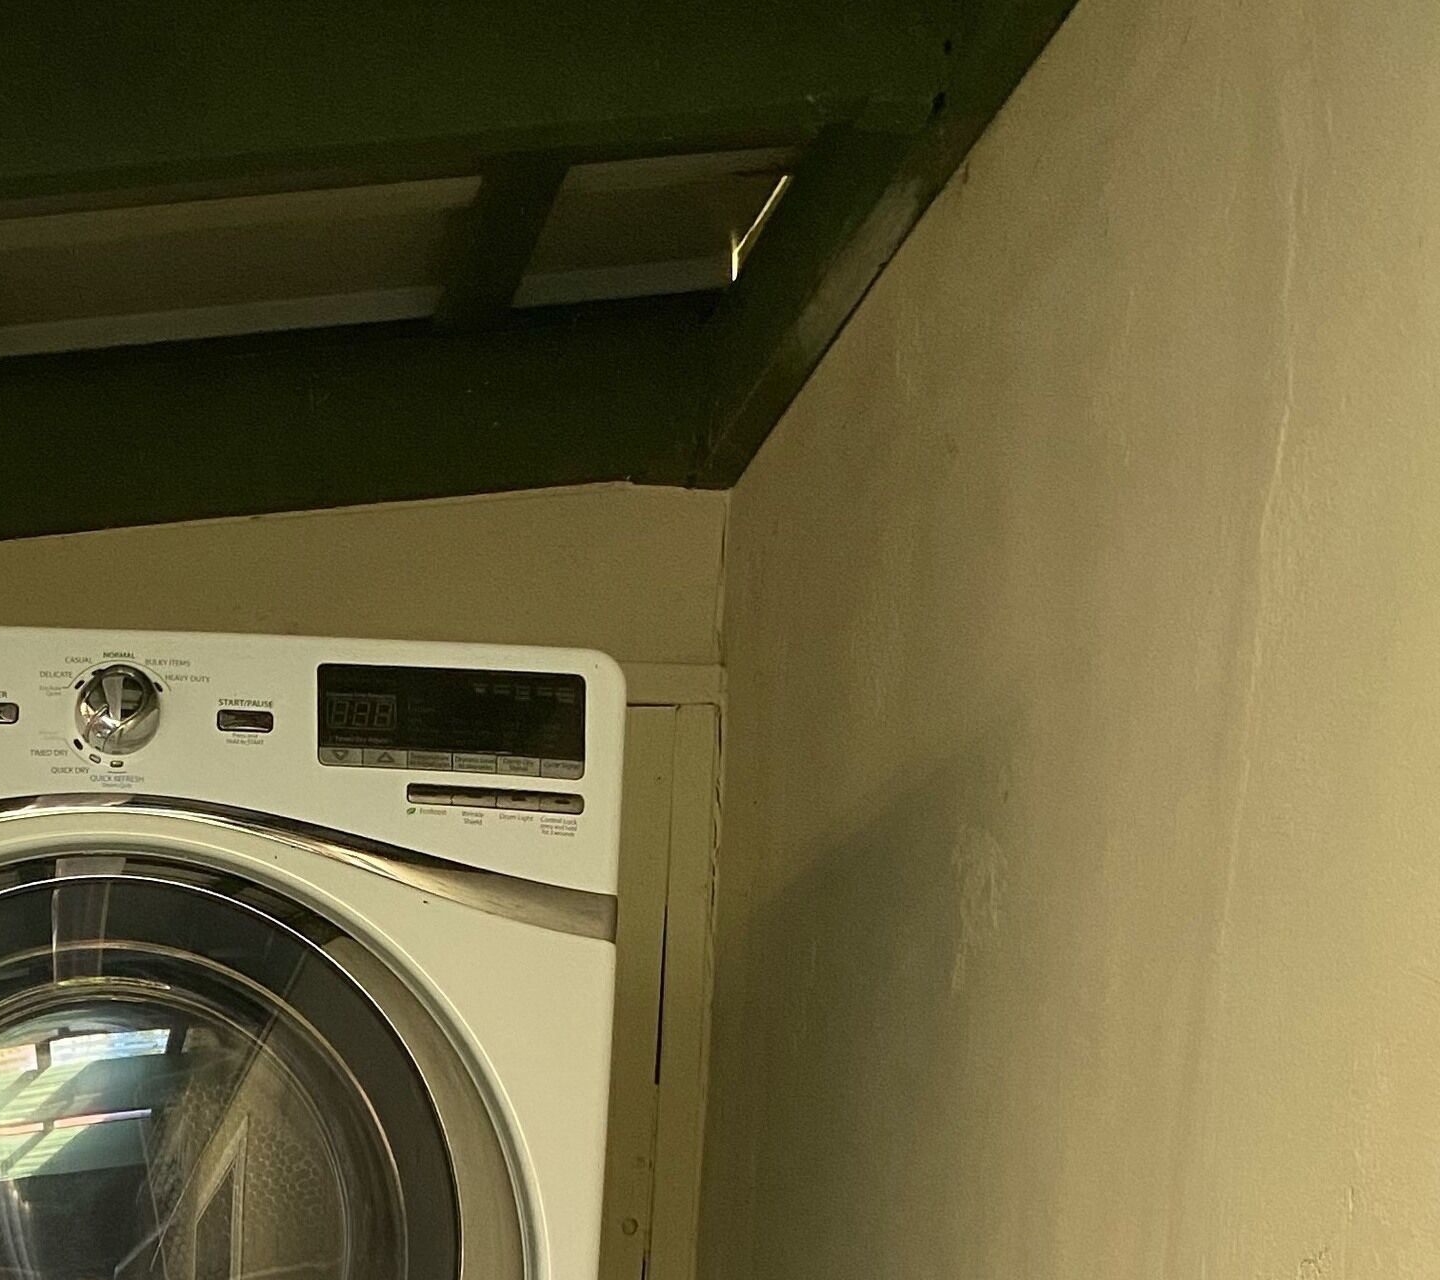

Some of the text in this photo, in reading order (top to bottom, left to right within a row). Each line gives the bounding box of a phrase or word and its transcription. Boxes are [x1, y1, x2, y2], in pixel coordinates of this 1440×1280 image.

[102, 651, 136, 659] NORMAL
[64, 656, 92, 664] CASUAL
[168, 659, 191, 667] ITEMS
[39, 670, 73, 679] DELICATE
[164, 674, 211, 684] HEAVY DUTY
[218, 699, 273, 708] START/PAUSE
[53, 749, 69, 757] DRY
[50, 766, 90, 775] QUICK DRY
[89, 775, 112, 783] QUICK
